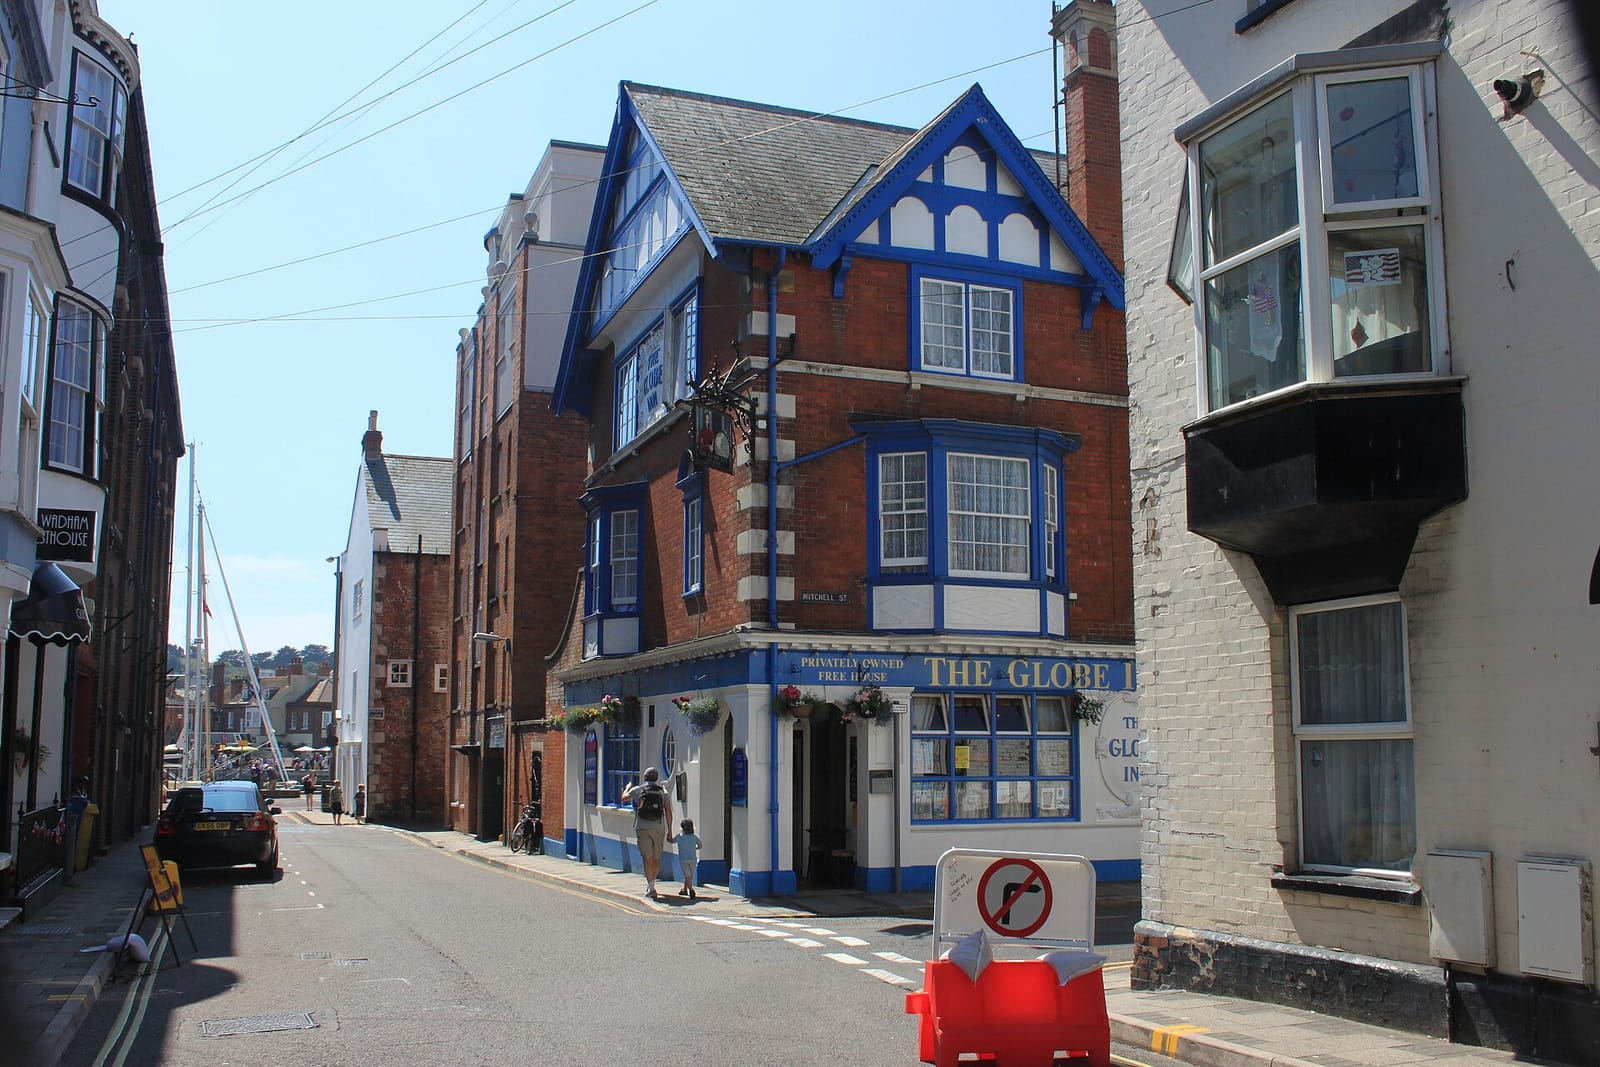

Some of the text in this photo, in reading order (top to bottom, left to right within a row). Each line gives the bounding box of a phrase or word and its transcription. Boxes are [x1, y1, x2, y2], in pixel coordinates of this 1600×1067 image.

[41, 513, 88, 529] WADHAM
[802, 592, 834, 601] MITCHELL
[801, 657, 904, 669] PRIVATELY OWNED
[818, 671, 888, 682] FREE HOUSE
[924, 657, 993, 687] THE
[1007, 658, 1110, 689] GLOBE
